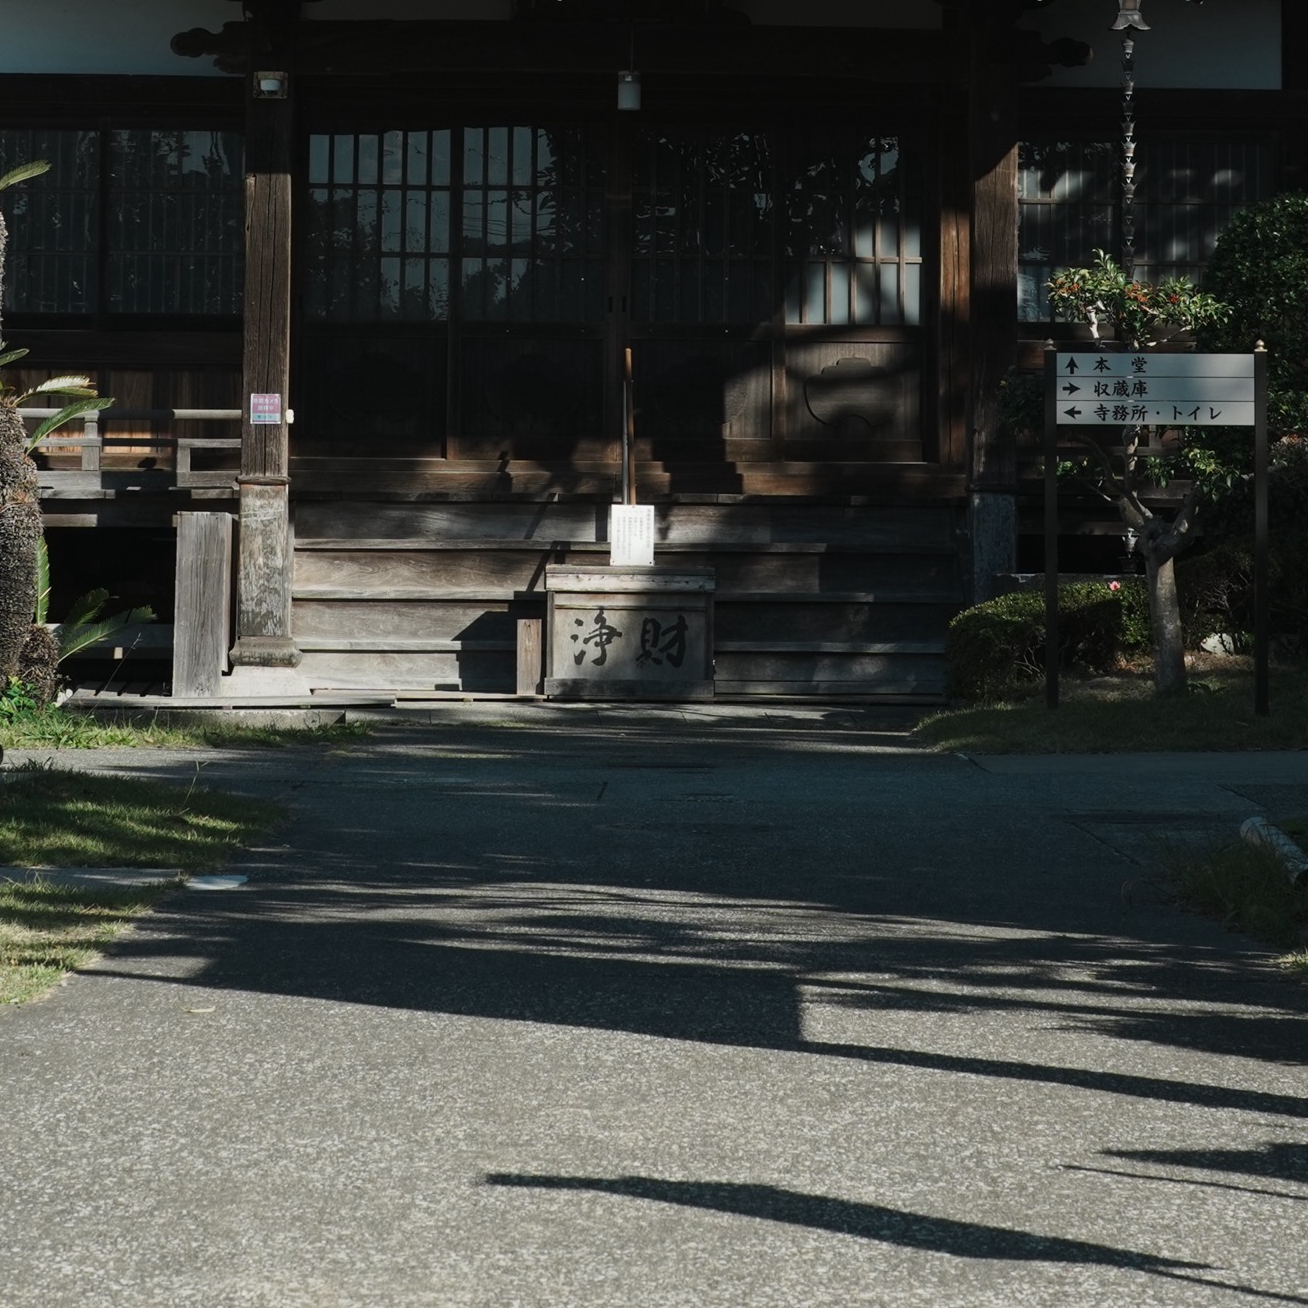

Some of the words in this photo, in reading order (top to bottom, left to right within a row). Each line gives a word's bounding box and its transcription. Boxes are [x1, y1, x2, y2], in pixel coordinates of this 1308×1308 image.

[1093, 379, 1148, 398] 収蔵庫
[1093, 403, 1222, 422] 寺務所・トイレ
[570, 608, 688, 668] 浄財
